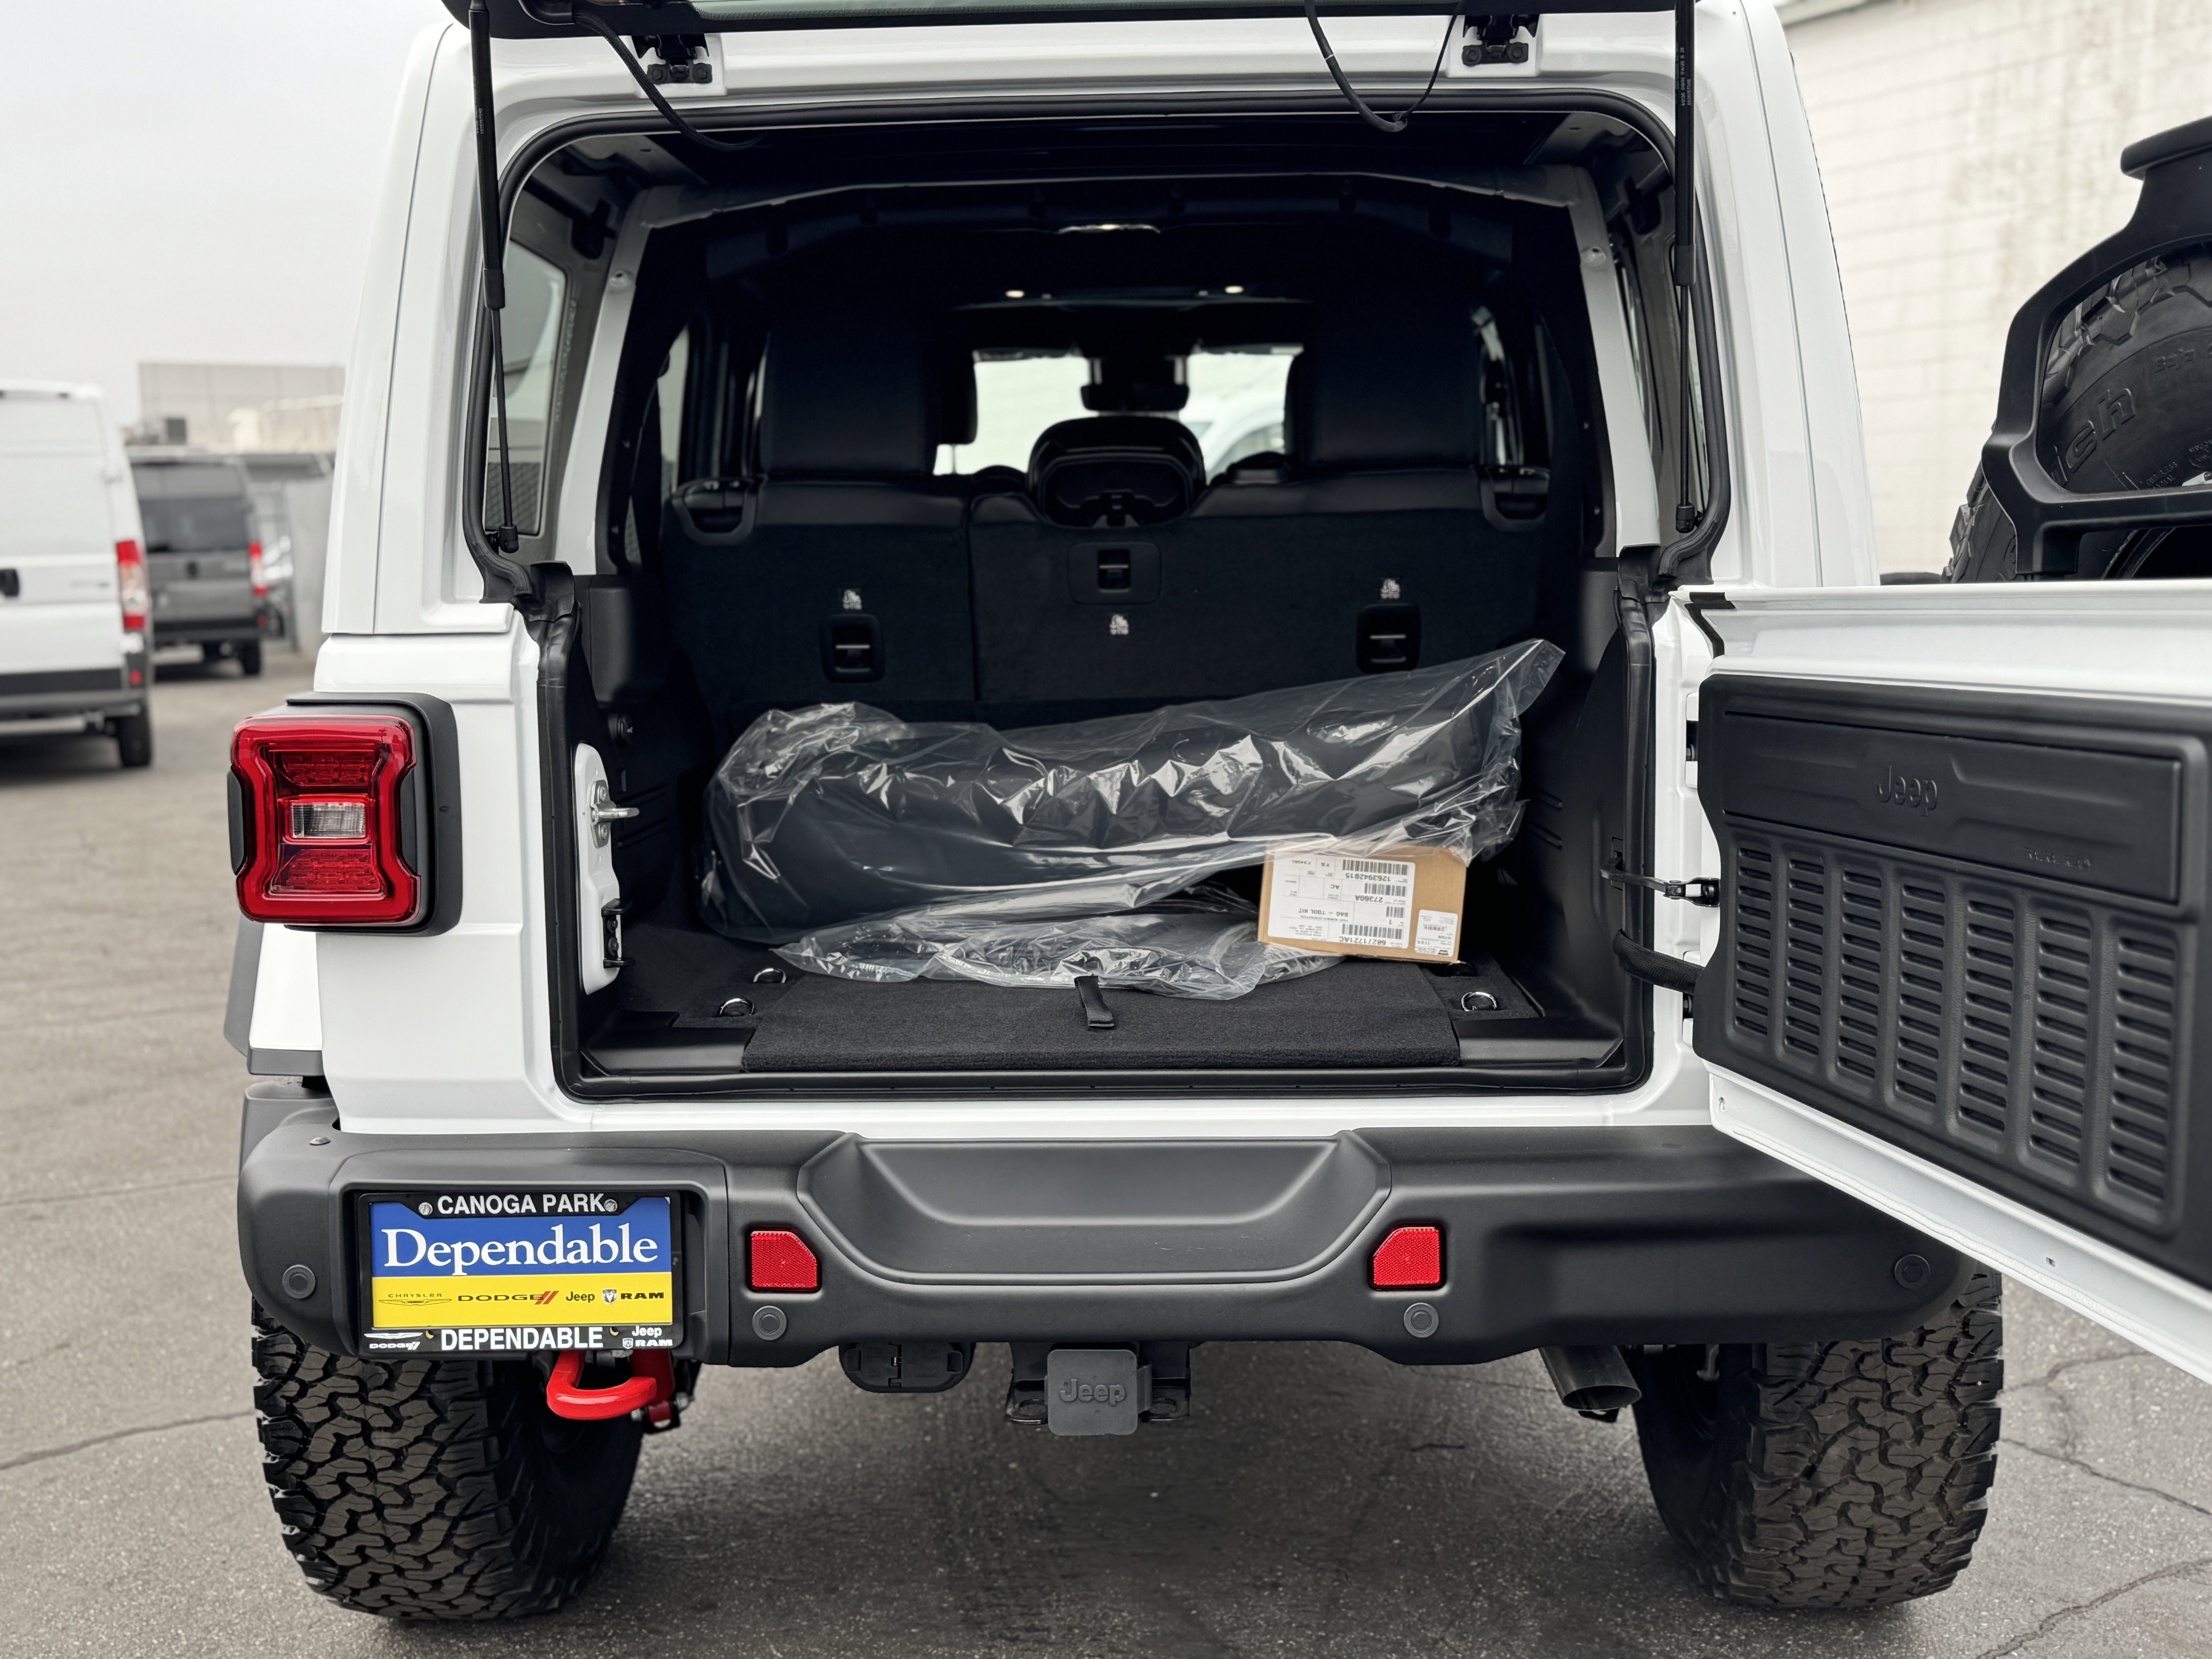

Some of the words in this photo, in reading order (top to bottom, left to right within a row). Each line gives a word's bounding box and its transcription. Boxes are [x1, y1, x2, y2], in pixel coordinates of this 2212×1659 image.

[2153, 349, 2197, 373] Baja
[1877, 765, 1938, 817] Jeep
[1345, 872, 1391, 882] 1263942015
[1355, 895, 1383, 903] 27360A
[1339, 936, 1386, 946] 68271721AC
[438, 1195, 537, 1215] CANOGA
[544, 1193, 605, 1213] PARK
[381, 1223, 658, 1276] Dependable
[566, 1291, 595, 1303] Jeep
[441, 1326, 603, 1350] DEPENDABLE
[632, 1325, 662, 1338] Jeep
[1059, 1378, 1127, 1406] Jeep
